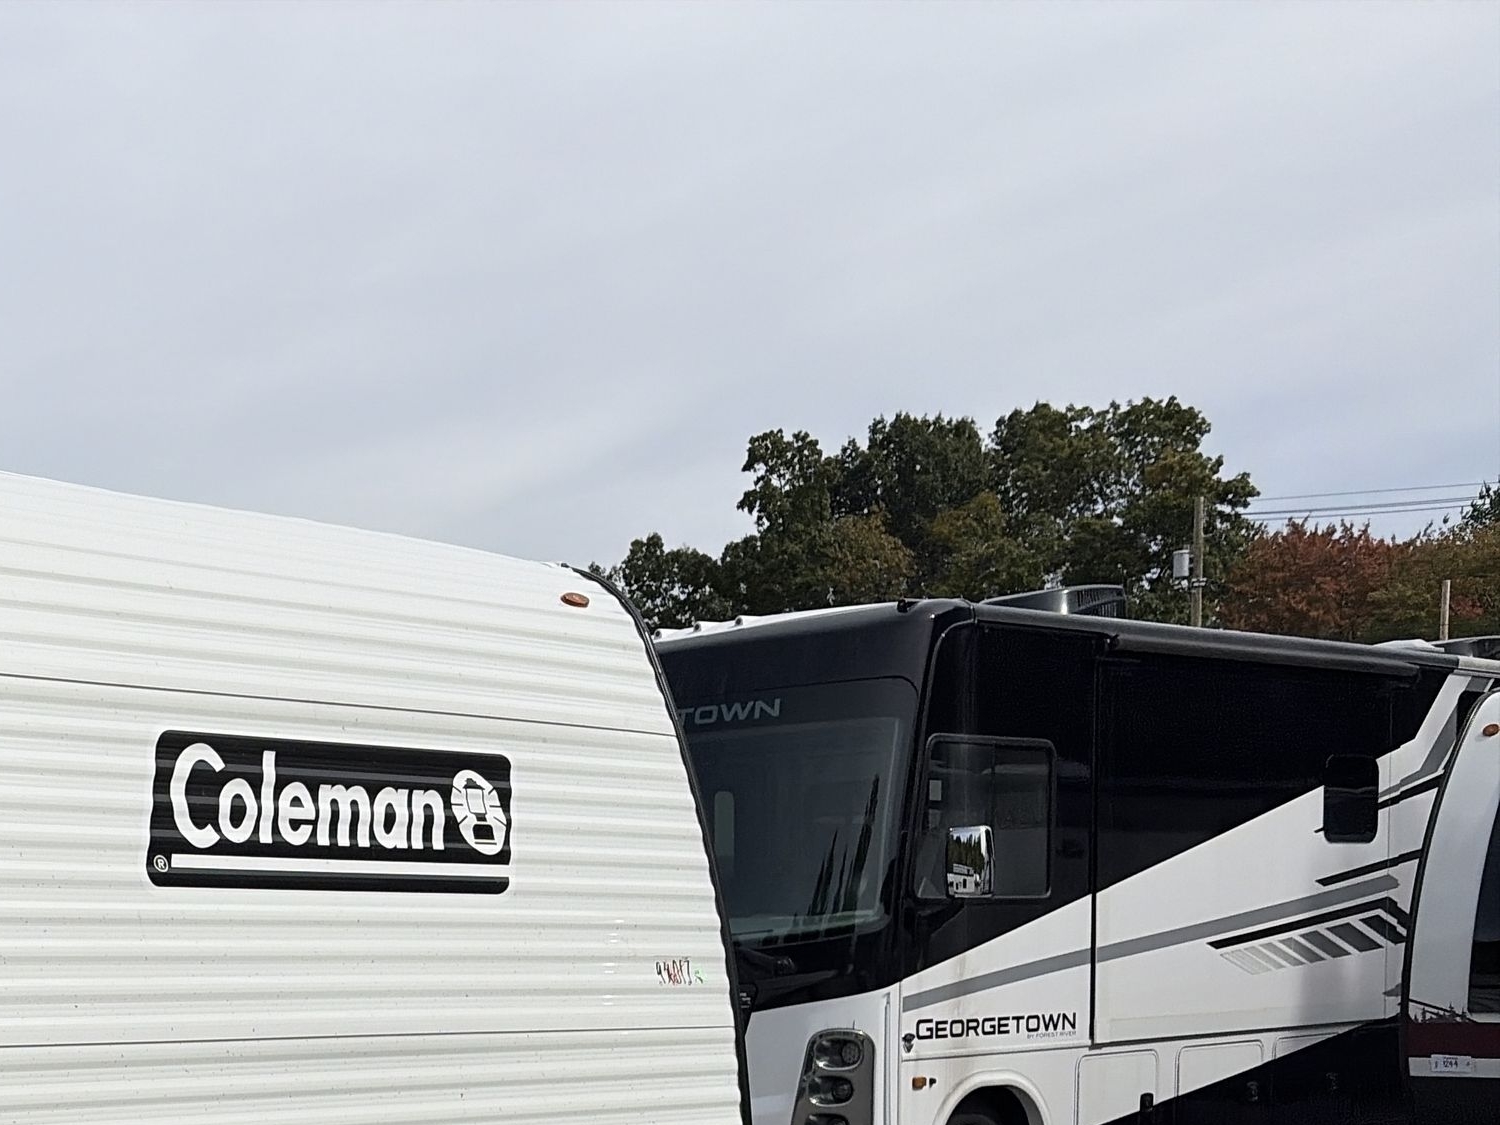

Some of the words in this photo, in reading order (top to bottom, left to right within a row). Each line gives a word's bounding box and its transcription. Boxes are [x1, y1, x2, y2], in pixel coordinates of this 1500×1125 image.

[169, 742, 446, 850] Coleman
[915, 1012, 1077, 1040] GEORGETOWN
[1035, 1031, 1058, 1039] FOREST
